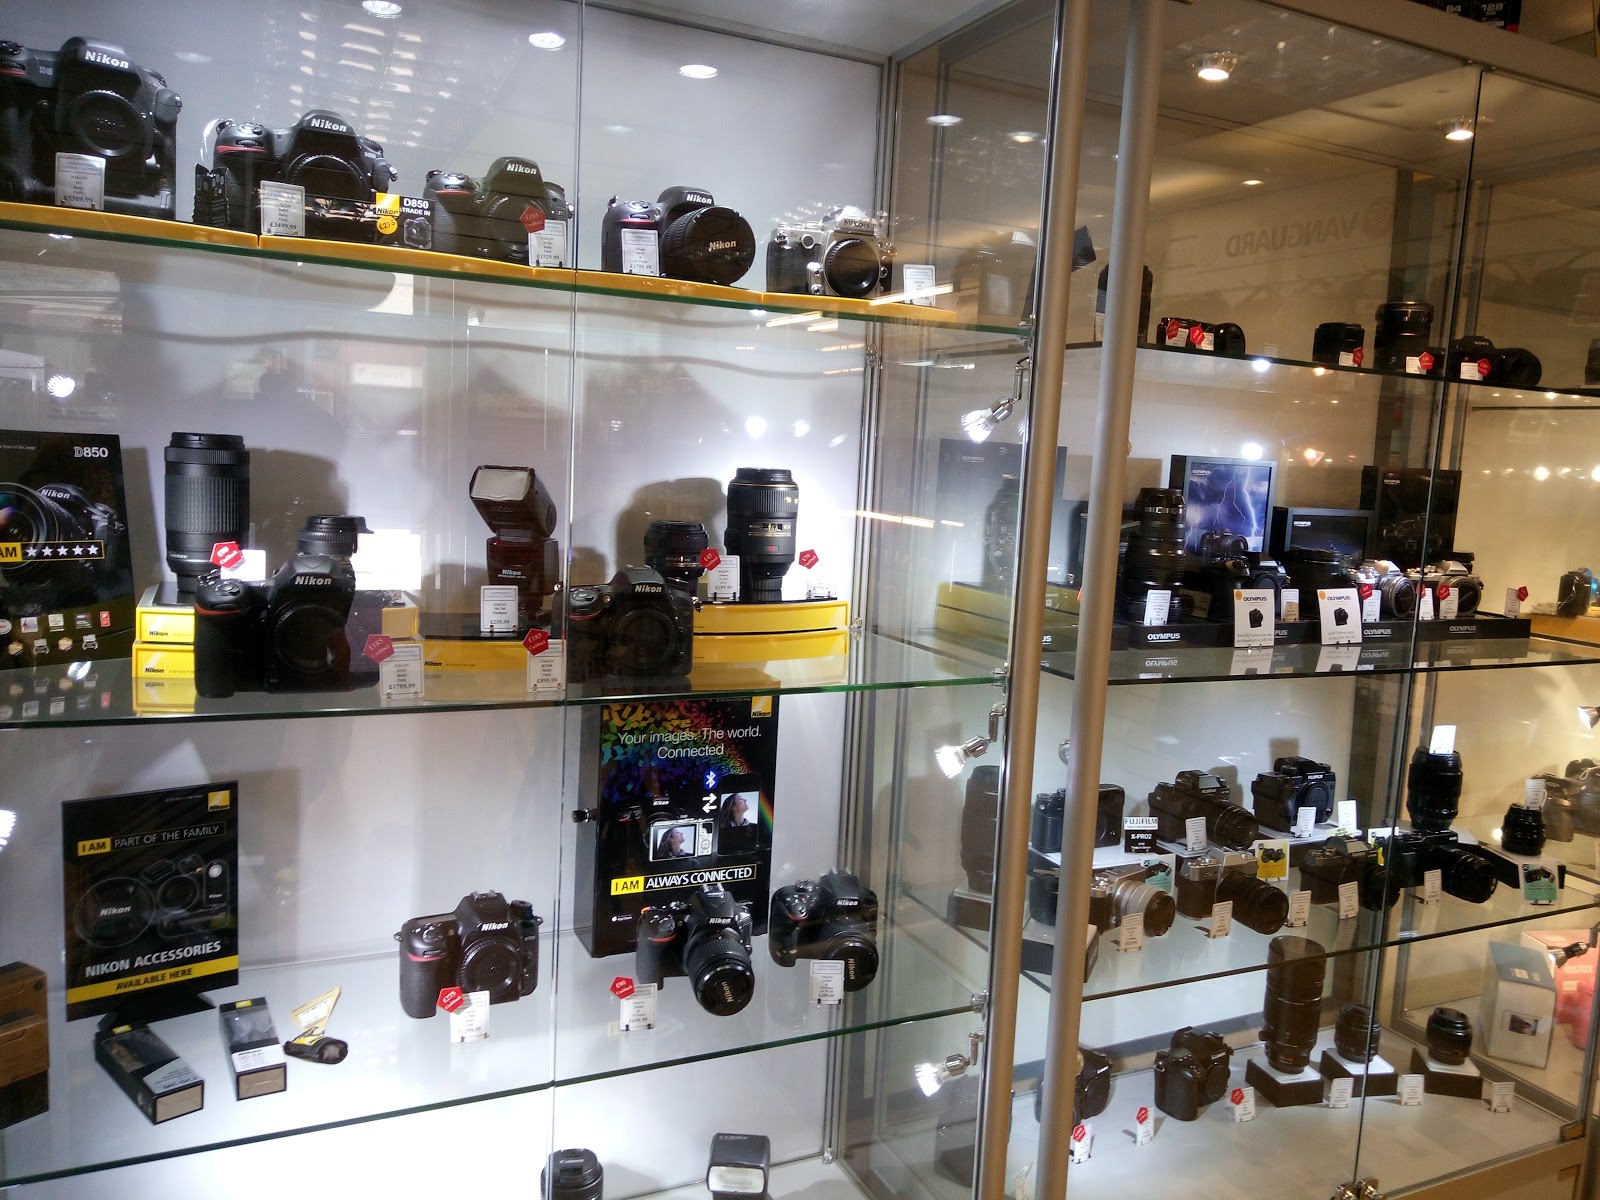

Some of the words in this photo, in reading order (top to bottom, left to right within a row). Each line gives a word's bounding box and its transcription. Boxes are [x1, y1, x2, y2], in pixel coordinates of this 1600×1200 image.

[85, 50, 129, 69] Nikon
[311, 118, 347, 132] Nikon
[506, 163, 537, 175] Nikon
[403, 198, 429, 209] D850
[686, 193, 712, 204] Nikon
[401, 207, 423, 215] TRADE
[708, 240, 737, 252] Nikon
[74, 446, 109, 458] D850
[40, 488, 71, 500] Nikon
[294, 575, 332, 586] Nikon
[634, 584, 662, 593] Nikon
[1147, 632, 1181, 640] OLYMPUS
[751, 710, 772, 718] Nikon
[617, 732, 647, 746] Your
[650, 730, 697, 746] images.
[701, 727, 724, 740] The
[727, 725, 762, 739] world.
[657, 744, 725, 760] Connected
[1124, 817, 1157, 825] FUJIFILM
[82, 843, 86, 853] I
[88, 842, 107, 852] AM
[114, 836, 140, 849] PART
[143, 834, 157, 844] OF
[161, 831, 181, 842] THE
[183, 824, 220, 838] FAMILY
[615, 881, 618, 892] I
[621, 879, 640, 891] AM
[646, 873, 690, 890] ALWAYS
[690, 866, 753, 884] CONNECTED
[100, 905, 132, 917] Nikon
[481, 921, 509, 932] Nikon
[709, 917, 731, 925] Nikon
[85, 957, 130, 978] NIKON
[133, 940, 222, 969] ACCESSORIES
[848, 958, 856, 980] Nikon
[115, 972, 166, 992] AVAILABLE
[169, 967, 193, 980] HERE
[722, 980, 735, 1003] Nikon
